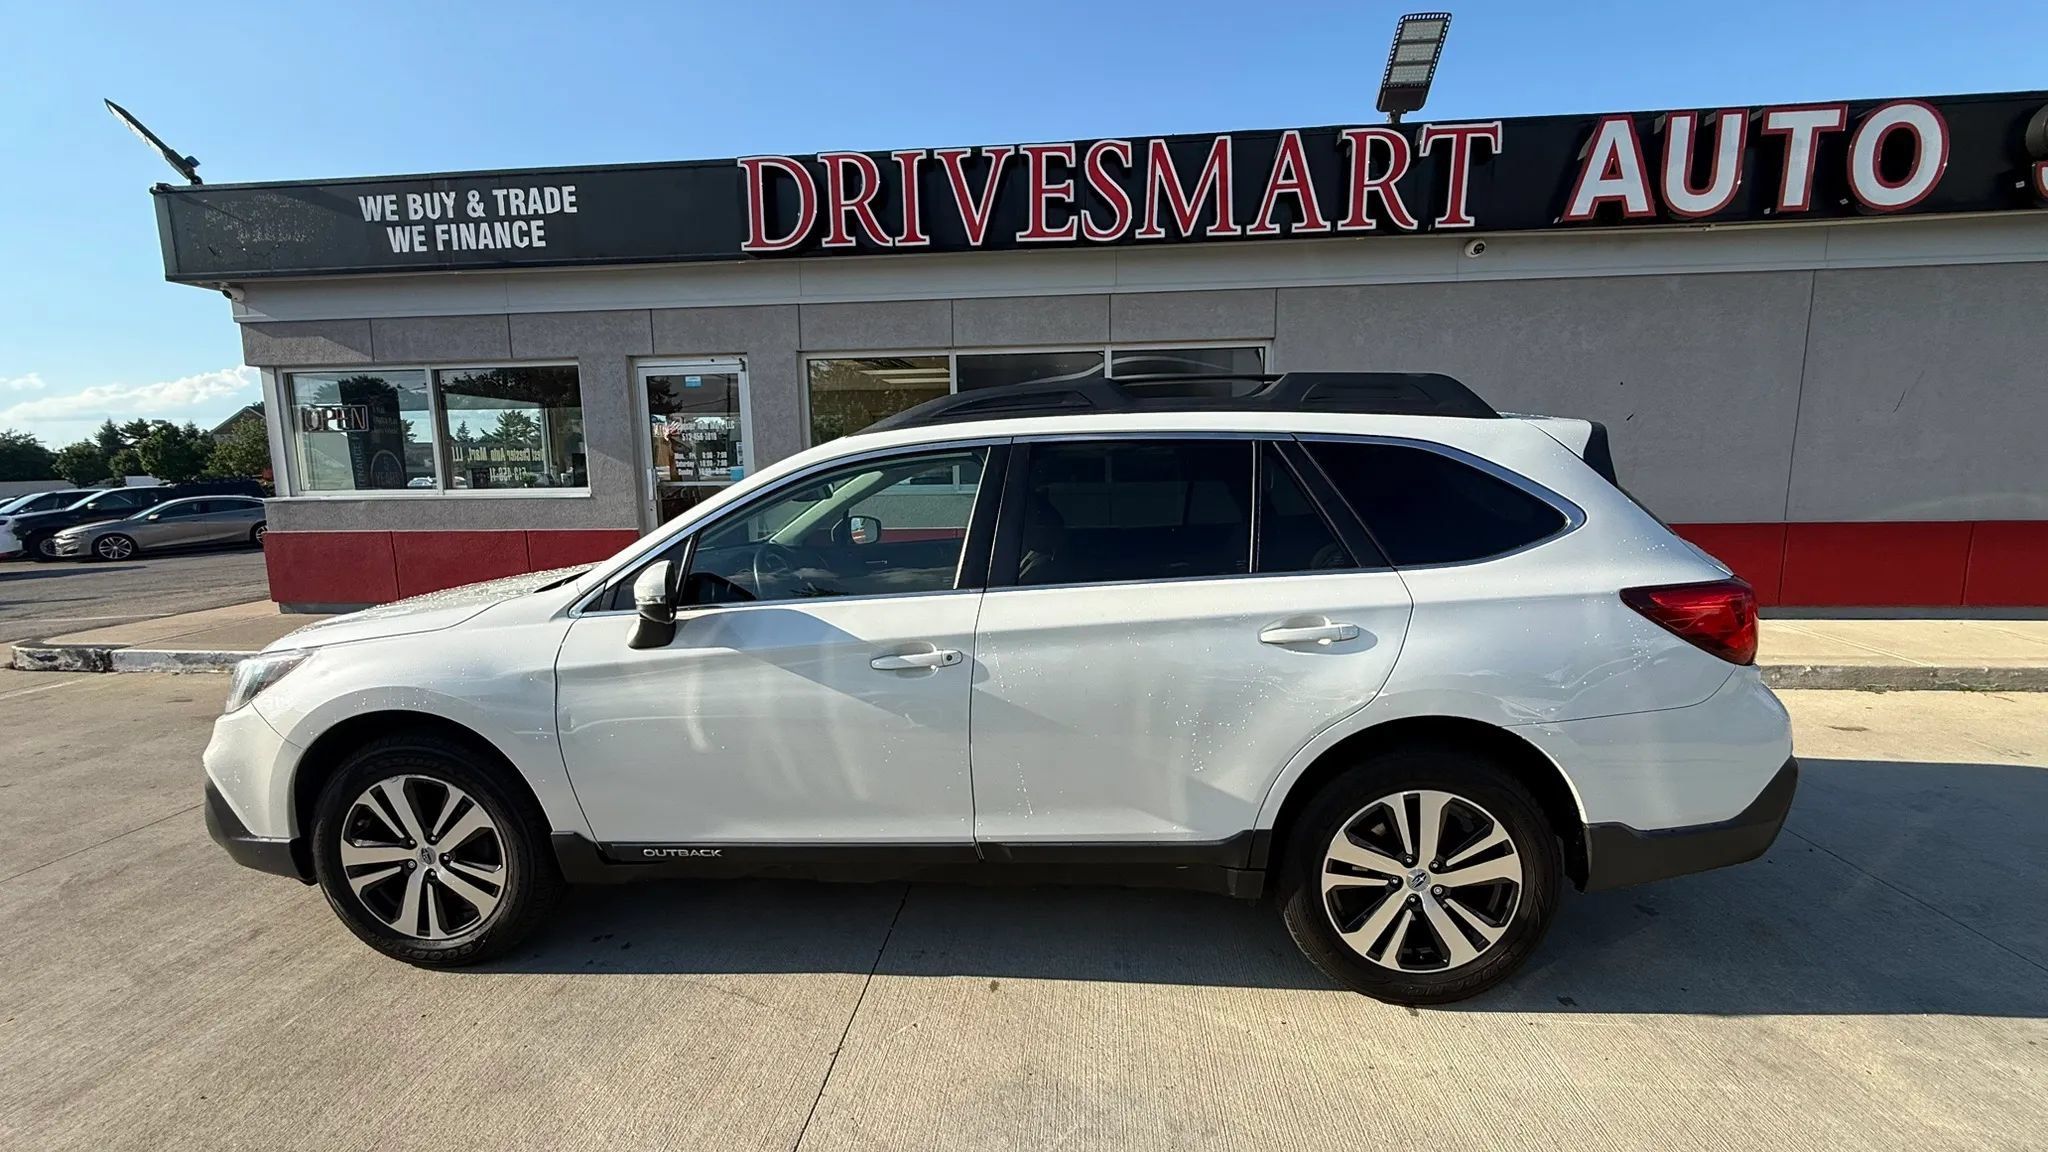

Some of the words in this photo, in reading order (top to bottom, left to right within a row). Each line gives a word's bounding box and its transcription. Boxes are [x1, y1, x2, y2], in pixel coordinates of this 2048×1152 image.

[737, 118, 1503, 252] DRIVESMART
[1562, 99, 1950, 222] AUTO
[358, 194, 400, 222] WE
[406, 191, 457, 221] BUY
[466, 189, 487, 218] &
[492, 185, 579, 216] TRADE
[386, 225, 428, 253] WE
[435, 219, 547, 252] FINANCE
[304, 406, 367, 431] OPEN
[643, 848, 722, 857] OUTBACK
